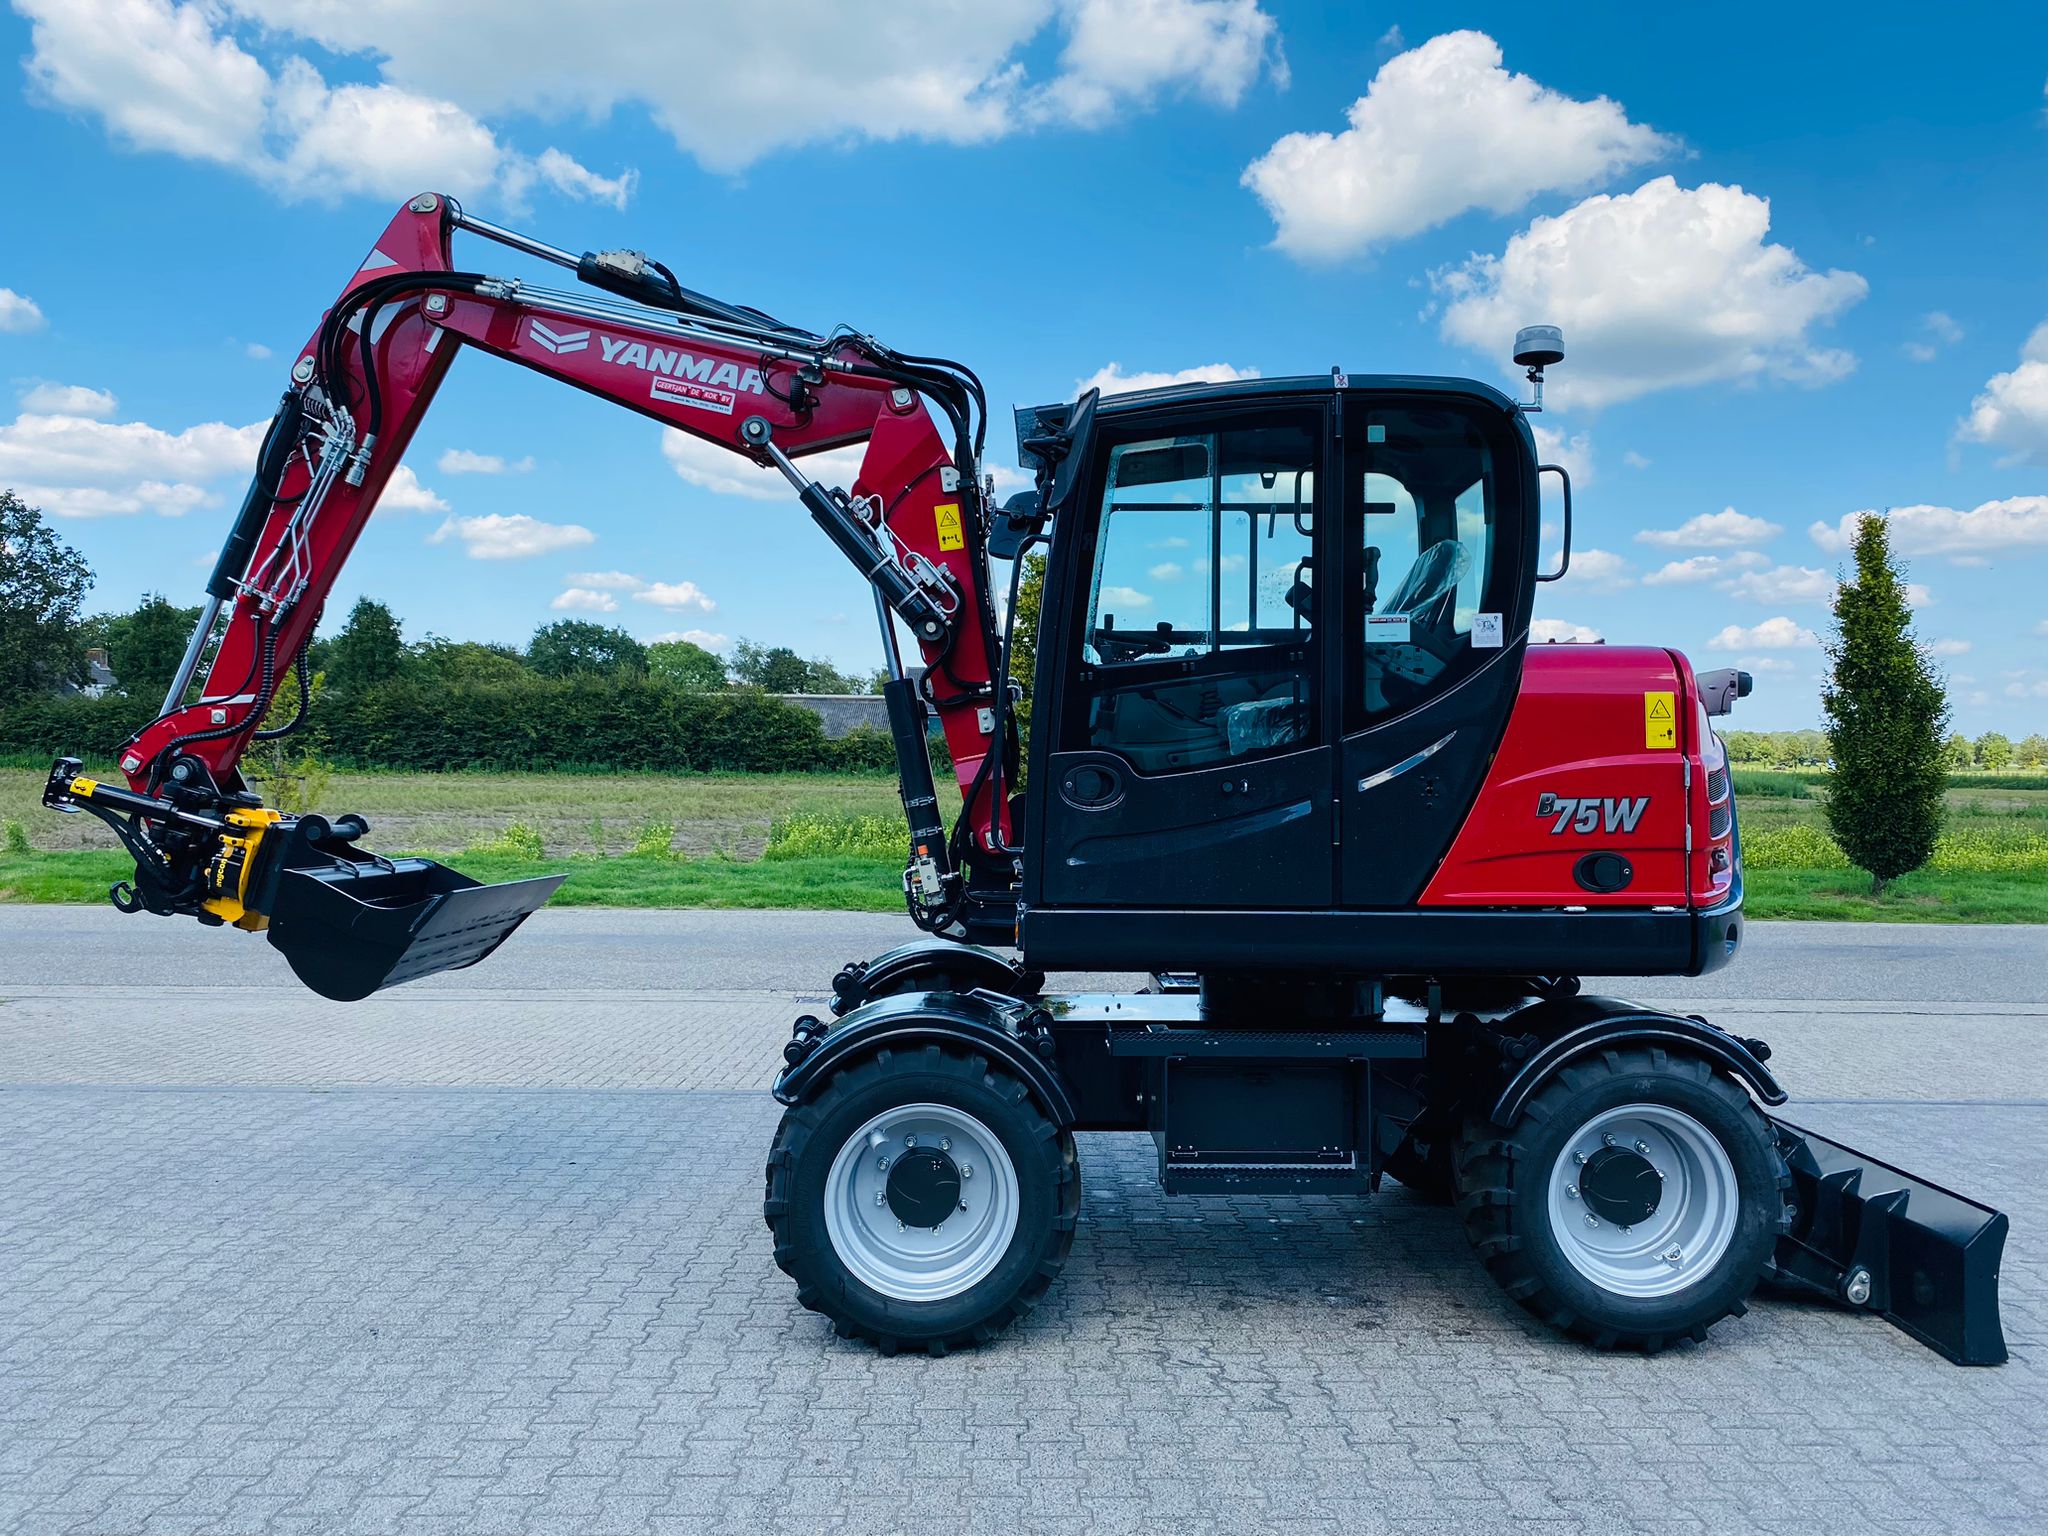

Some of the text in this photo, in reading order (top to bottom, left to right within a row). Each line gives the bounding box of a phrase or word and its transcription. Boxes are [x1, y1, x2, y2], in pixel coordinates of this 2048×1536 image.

[600, 336, 768, 395] YANMAR
[690, 388, 700, 396] DE
[703, 391, 719, 400] KOK
[216, 858, 228, 888] engcon
